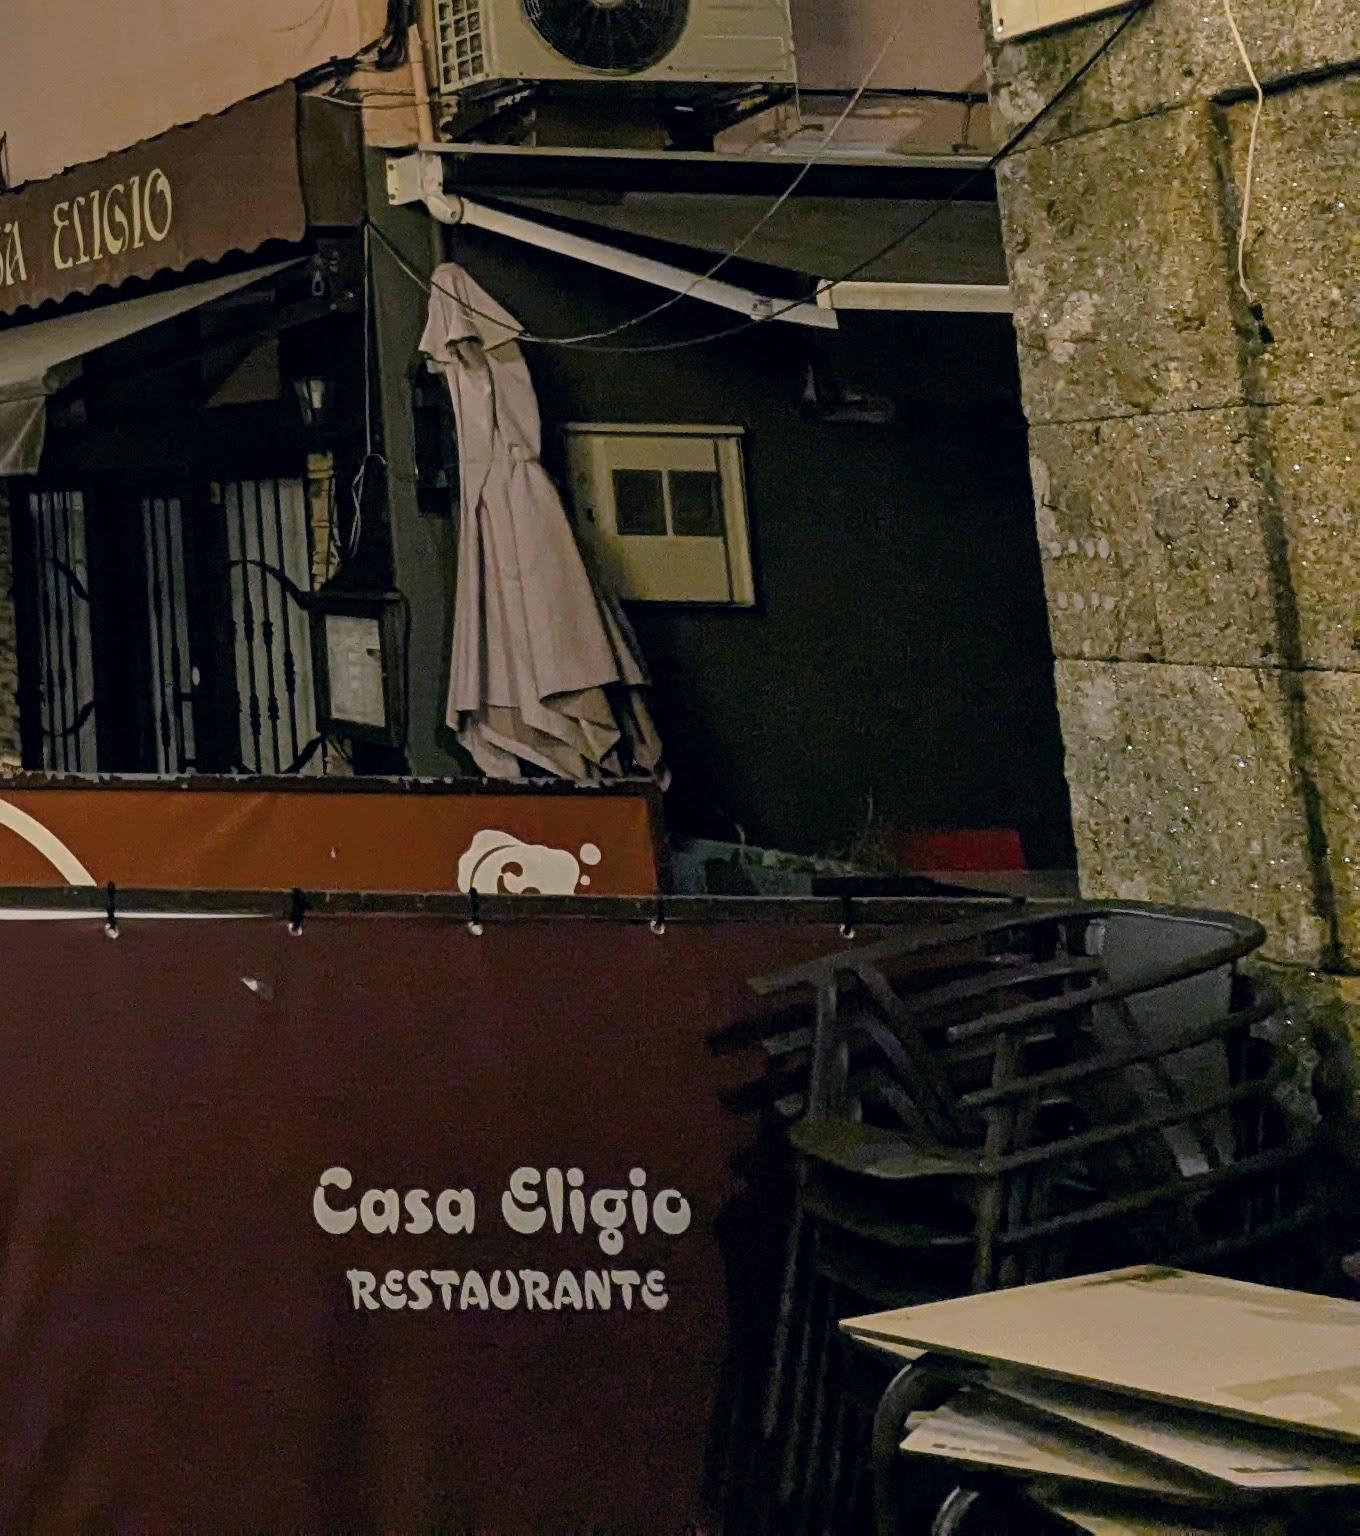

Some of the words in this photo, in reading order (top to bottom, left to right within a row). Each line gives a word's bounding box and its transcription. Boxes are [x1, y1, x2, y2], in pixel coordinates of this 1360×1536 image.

[53, 167, 173, 271] ELIGIO
[313, 1166, 476, 1235] Casa
[501, 1166, 692, 1256] Eligio
[346, 1269, 670, 1311] RESTAURANTE
